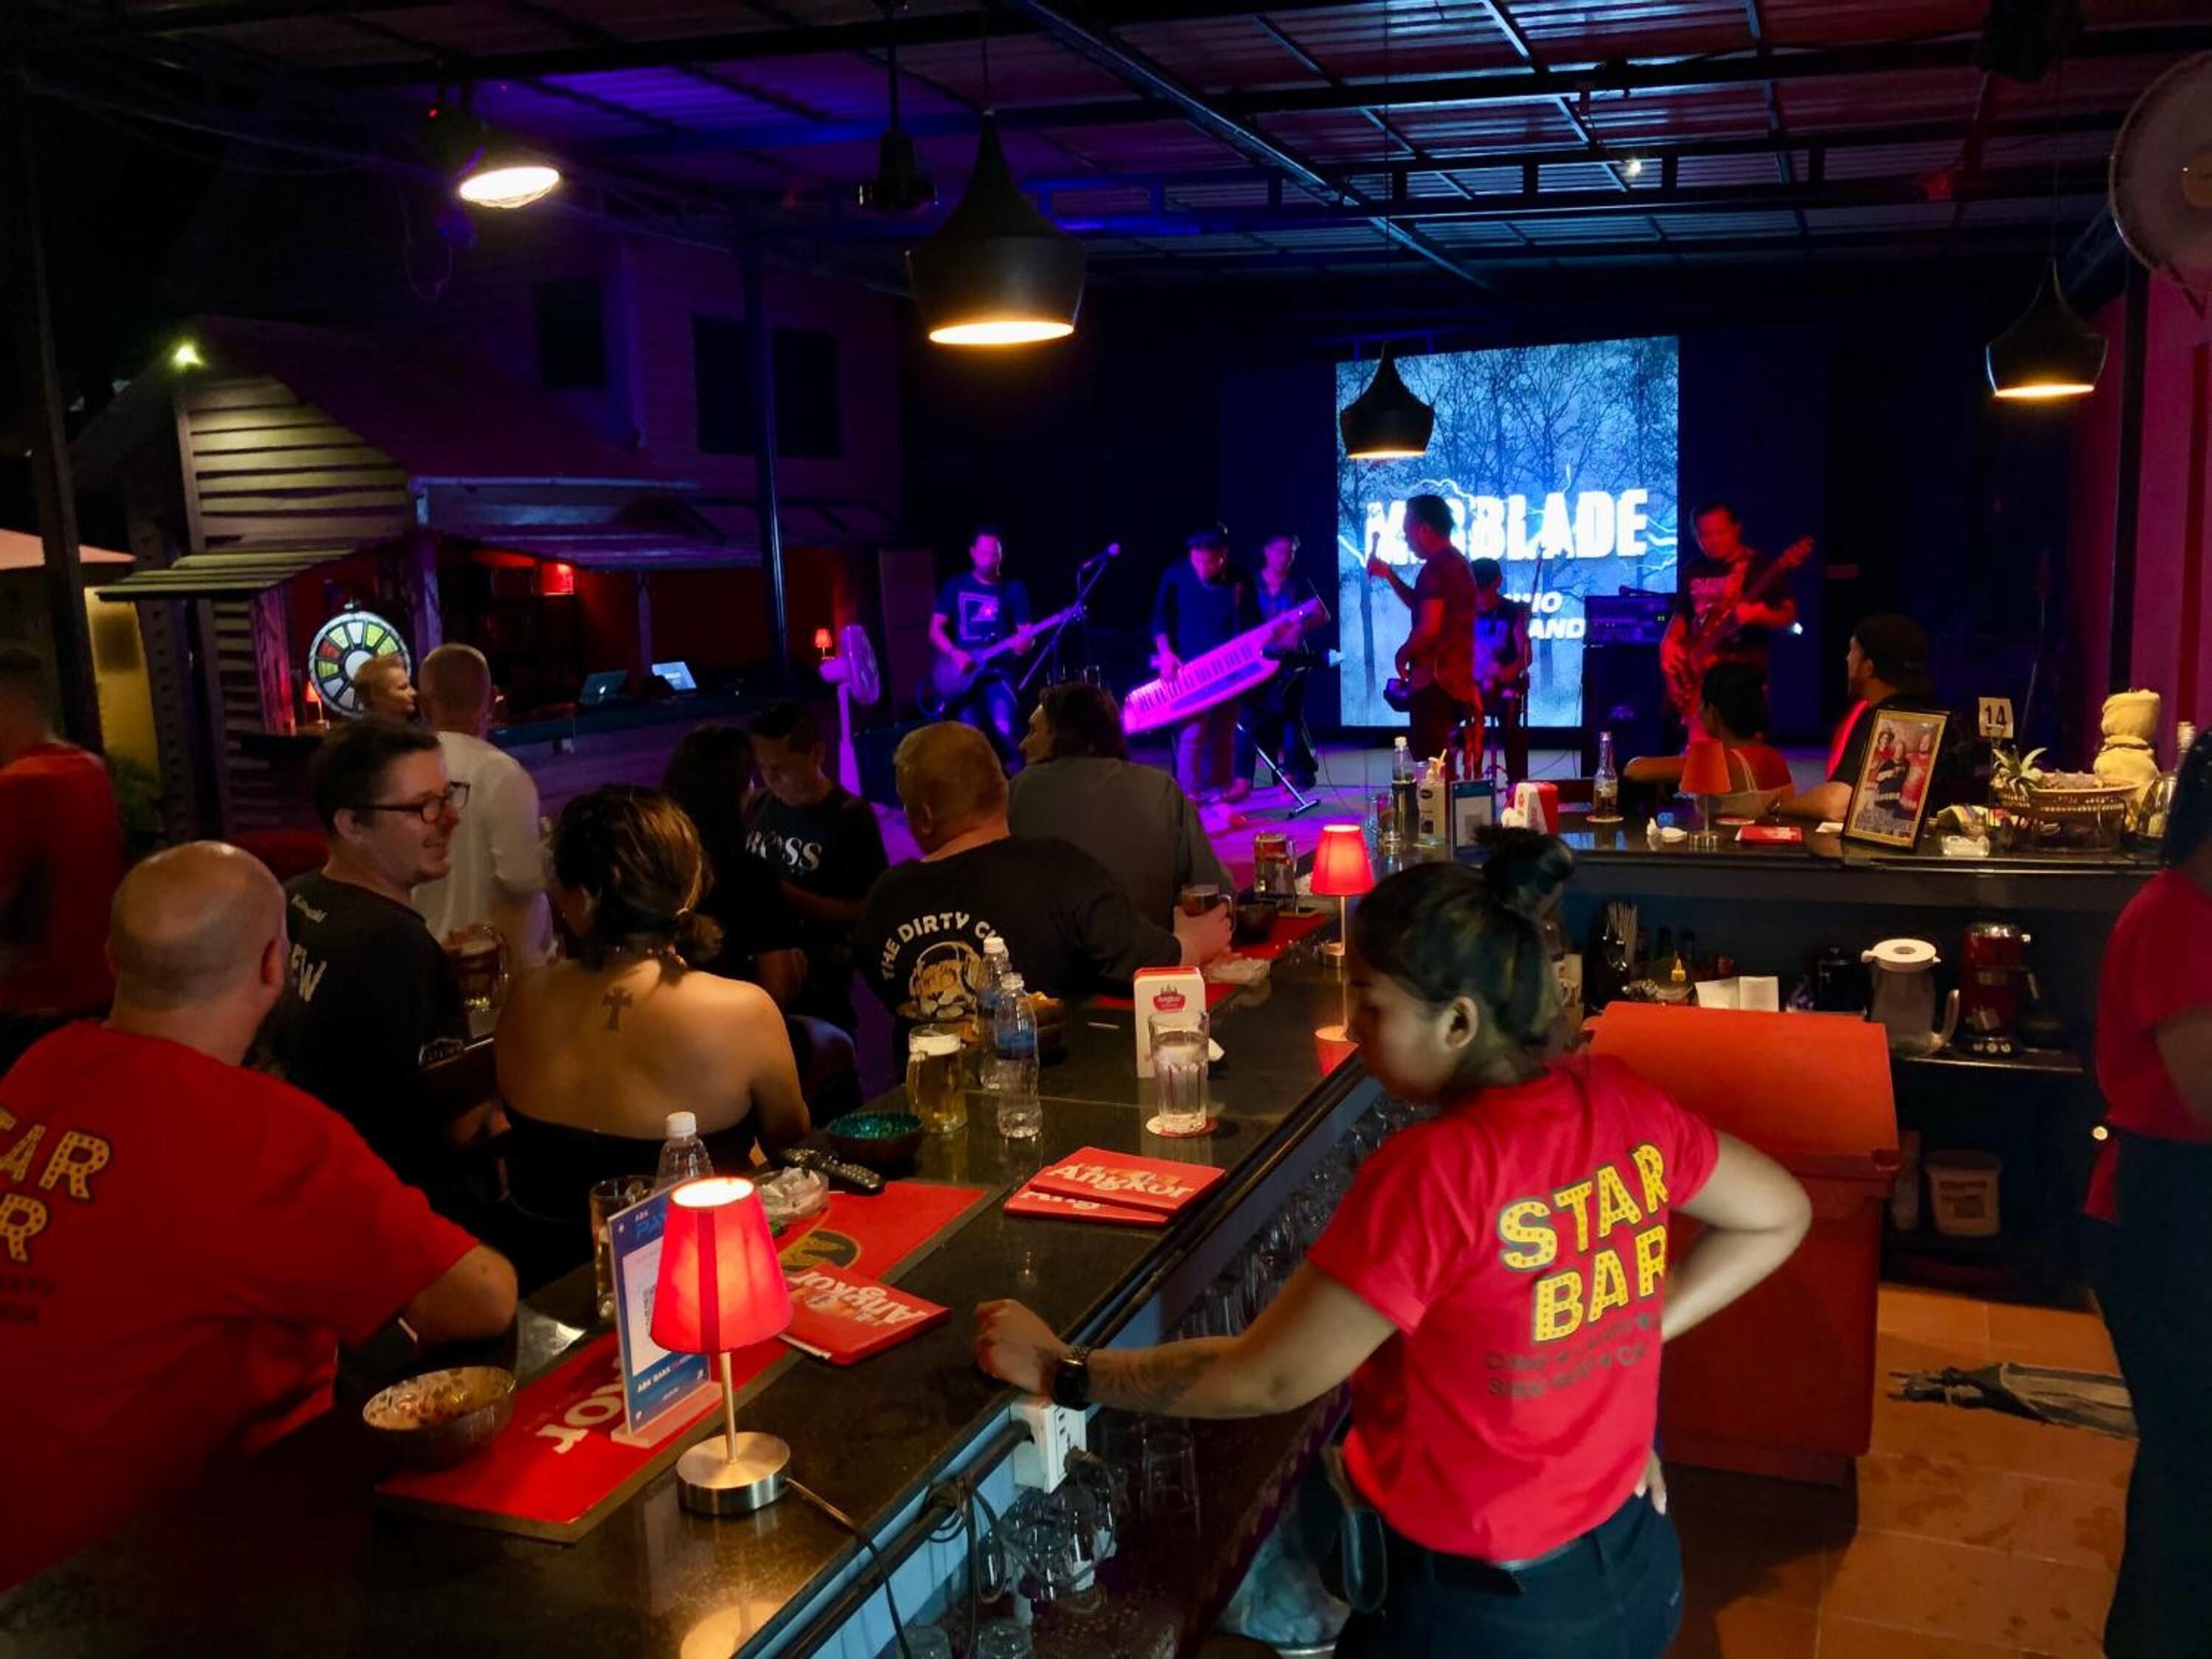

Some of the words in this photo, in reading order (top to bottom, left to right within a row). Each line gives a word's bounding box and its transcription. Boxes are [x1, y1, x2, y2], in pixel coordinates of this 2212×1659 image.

[1985, 705, 2007, 726] 14
[880, 937, 901, 981] THE
[896, 911, 970, 944] DIRTY
[1044, 1163, 1196, 1199] Angkor
[1498, 1144, 1669, 1270] STAR
[786, 1271, 930, 1326] Angkor
[1533, 1224, 1667, 1343] BAR
